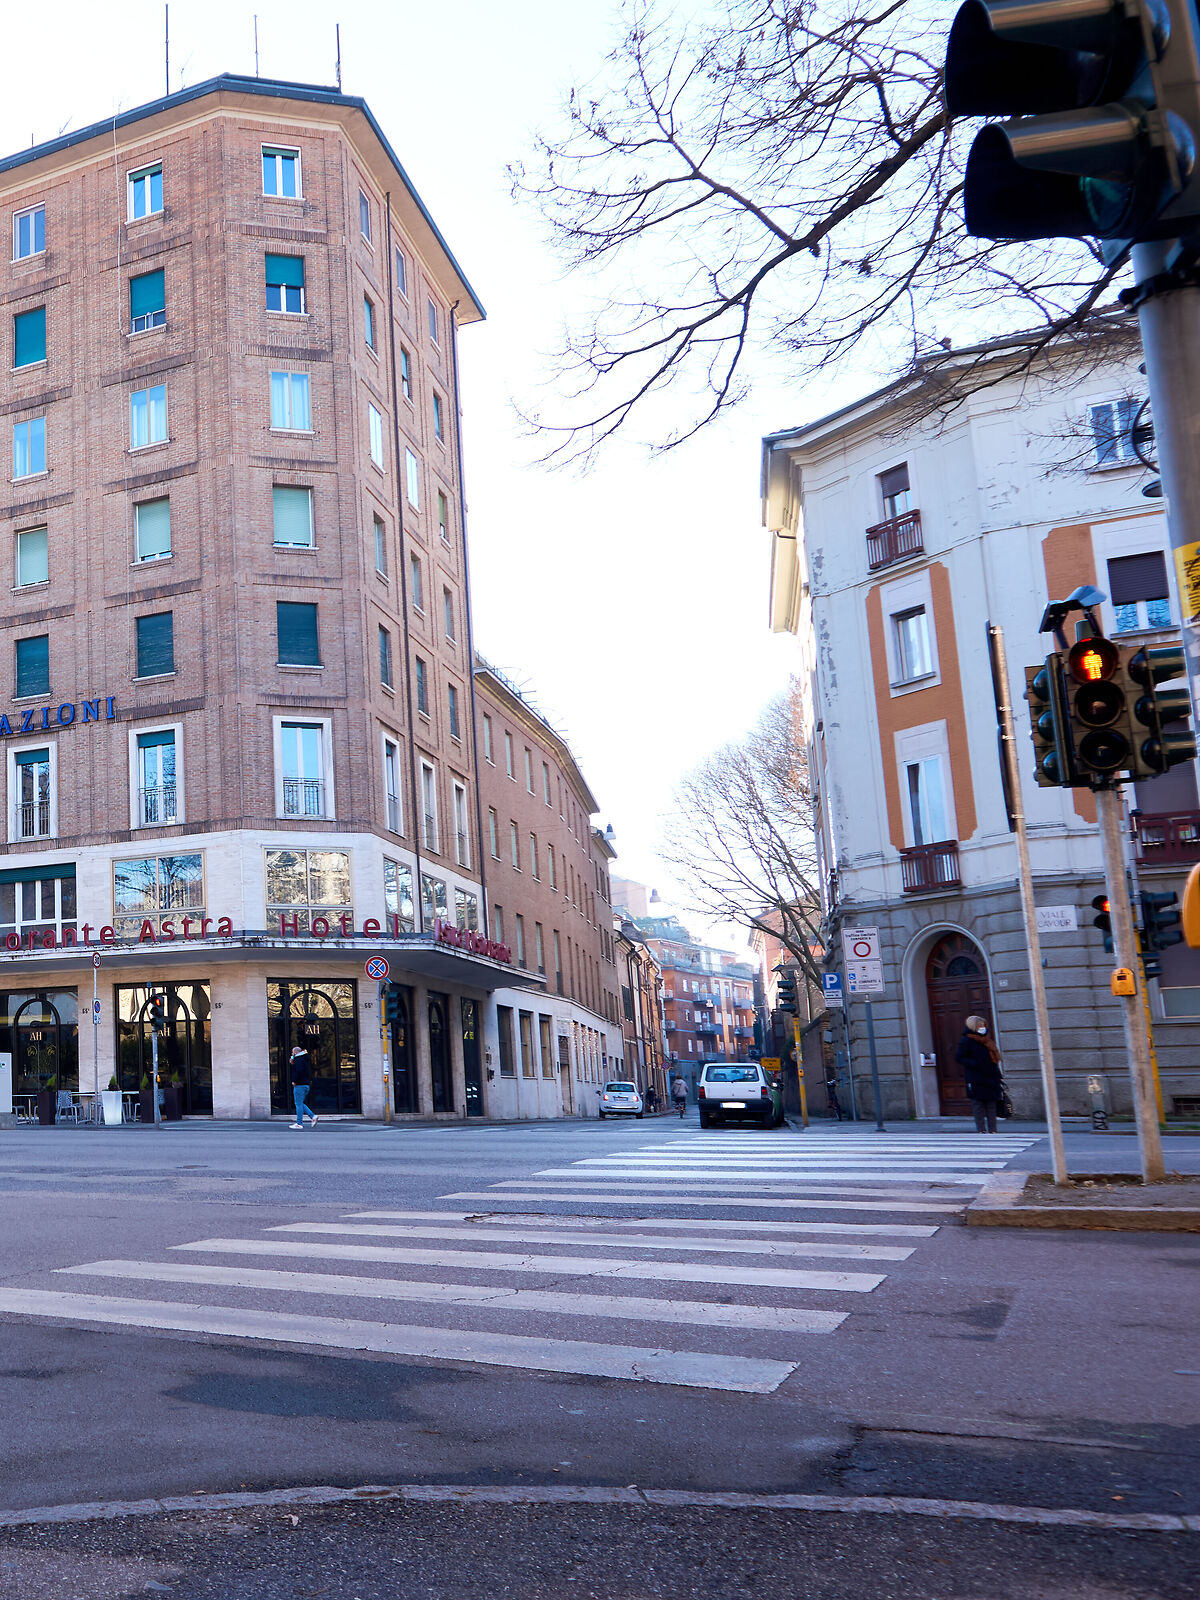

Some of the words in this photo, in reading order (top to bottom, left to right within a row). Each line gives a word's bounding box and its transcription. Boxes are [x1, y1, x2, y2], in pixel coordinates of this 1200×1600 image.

[139, 915, 234, 943] Astra
[279, 913, 399, 939] Hotel
[825, 974, 838, 989] P
[30, 1031, 42, 1040] AH
